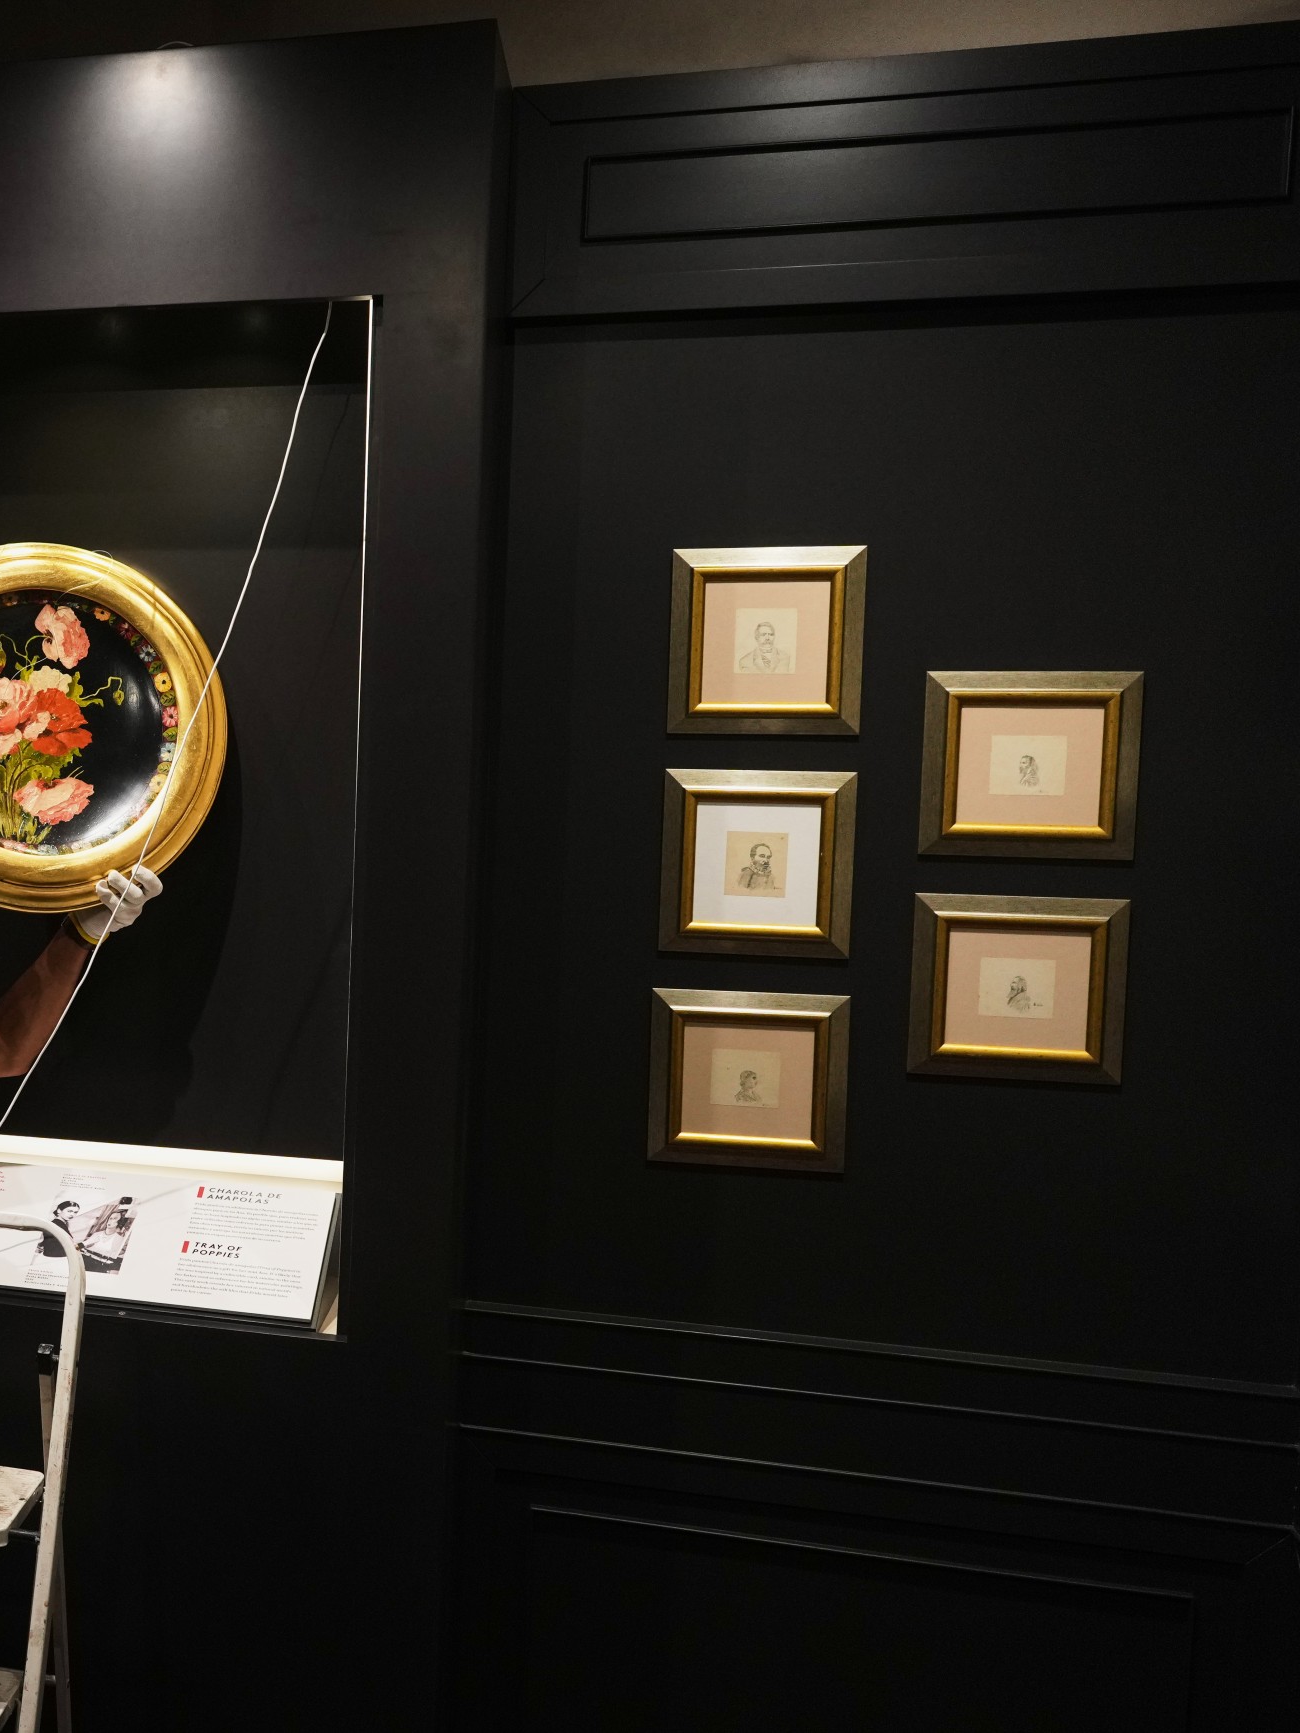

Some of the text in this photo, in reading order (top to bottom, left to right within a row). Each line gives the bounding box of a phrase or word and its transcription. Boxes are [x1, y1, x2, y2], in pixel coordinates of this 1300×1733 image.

[208, 1187, 283, 1200] CHAROLA DE
[206, 1194, 270, 1205] AMAPOLAS
[194, 1241, 223, 1250] TRAY
[192, 1248, 241, 1259] POPPIES
